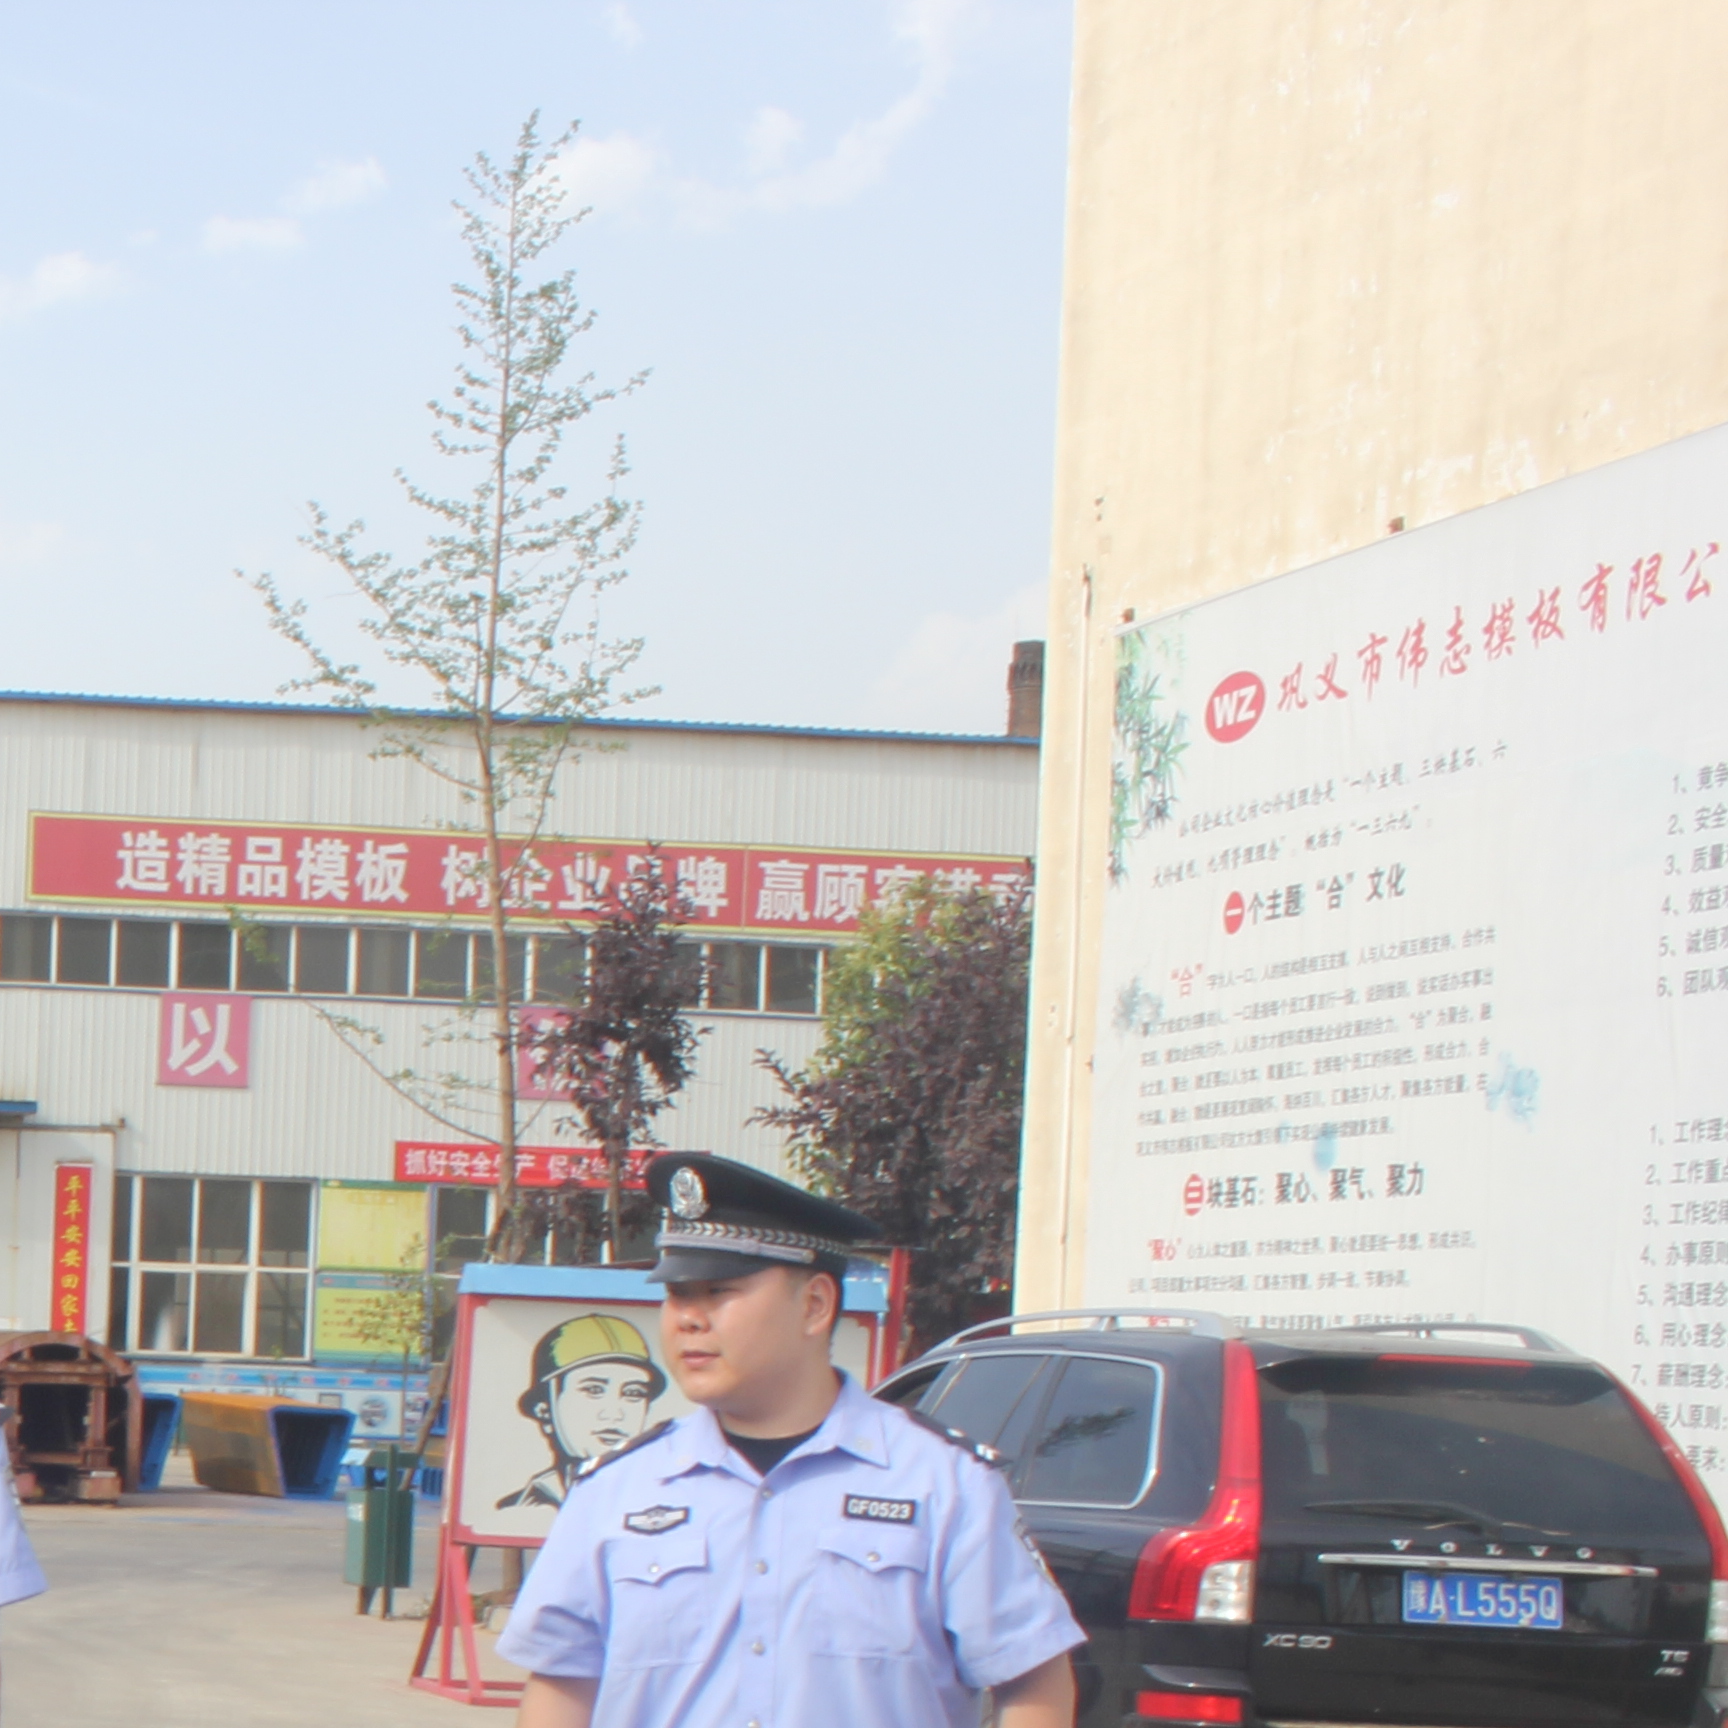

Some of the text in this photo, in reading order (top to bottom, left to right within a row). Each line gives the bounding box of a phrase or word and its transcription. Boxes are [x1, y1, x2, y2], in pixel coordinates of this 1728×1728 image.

[1276, 541, 1722, 713] 巩义市伟志模板有限公
[1212, 684, 1259, 730] WZ
[114, 830, 412, 904] 造精品模板
[1663, 843, 1728, 876] 3、质量
[165, 1002, 242, 1078] 以
[846, 1497, 912, 1521] GF0523
[1390, 1538, 1594, 1559] VOLVO
